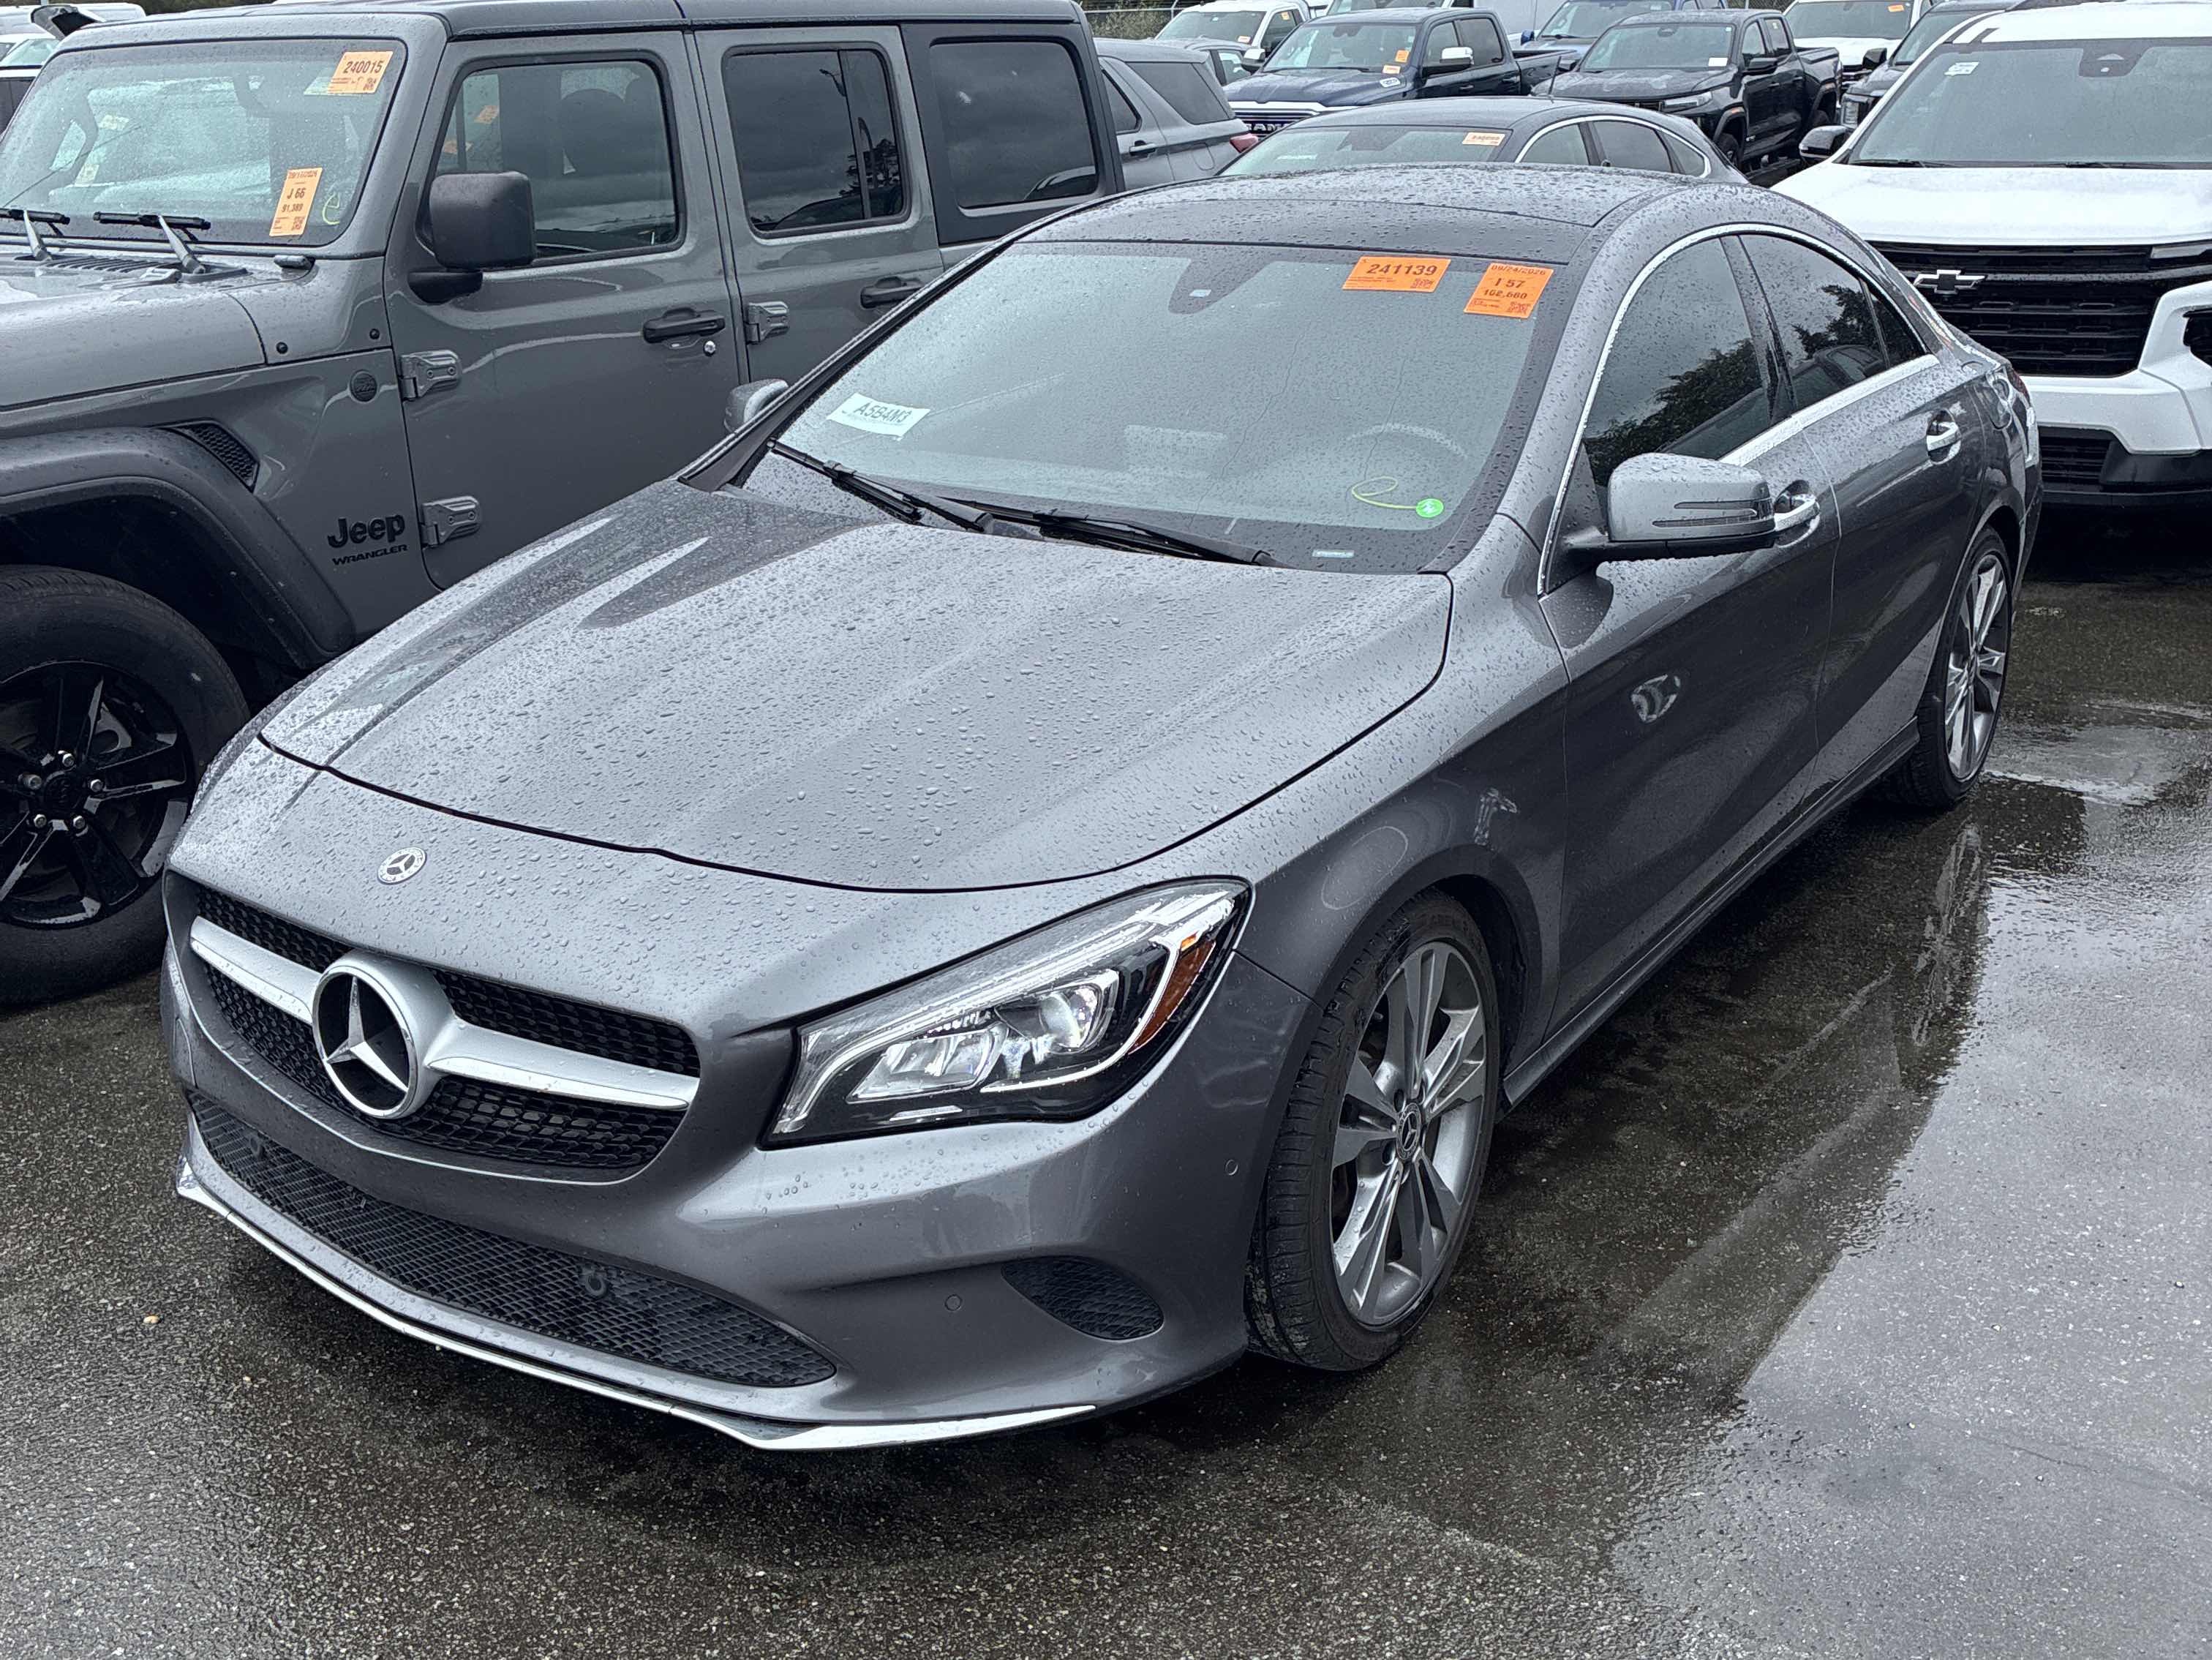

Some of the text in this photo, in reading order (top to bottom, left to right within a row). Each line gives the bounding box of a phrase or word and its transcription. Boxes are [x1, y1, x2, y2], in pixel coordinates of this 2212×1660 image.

[342, 60, 385, 73] 240015
[287, 188, 294, 199] J
[1366, 263, 1438, 276] 241139
[1505, 279, 1526, 288] 57
[327, 514, 405, 548] Jeep
[332, 544, 408, 566] WRANGLER
